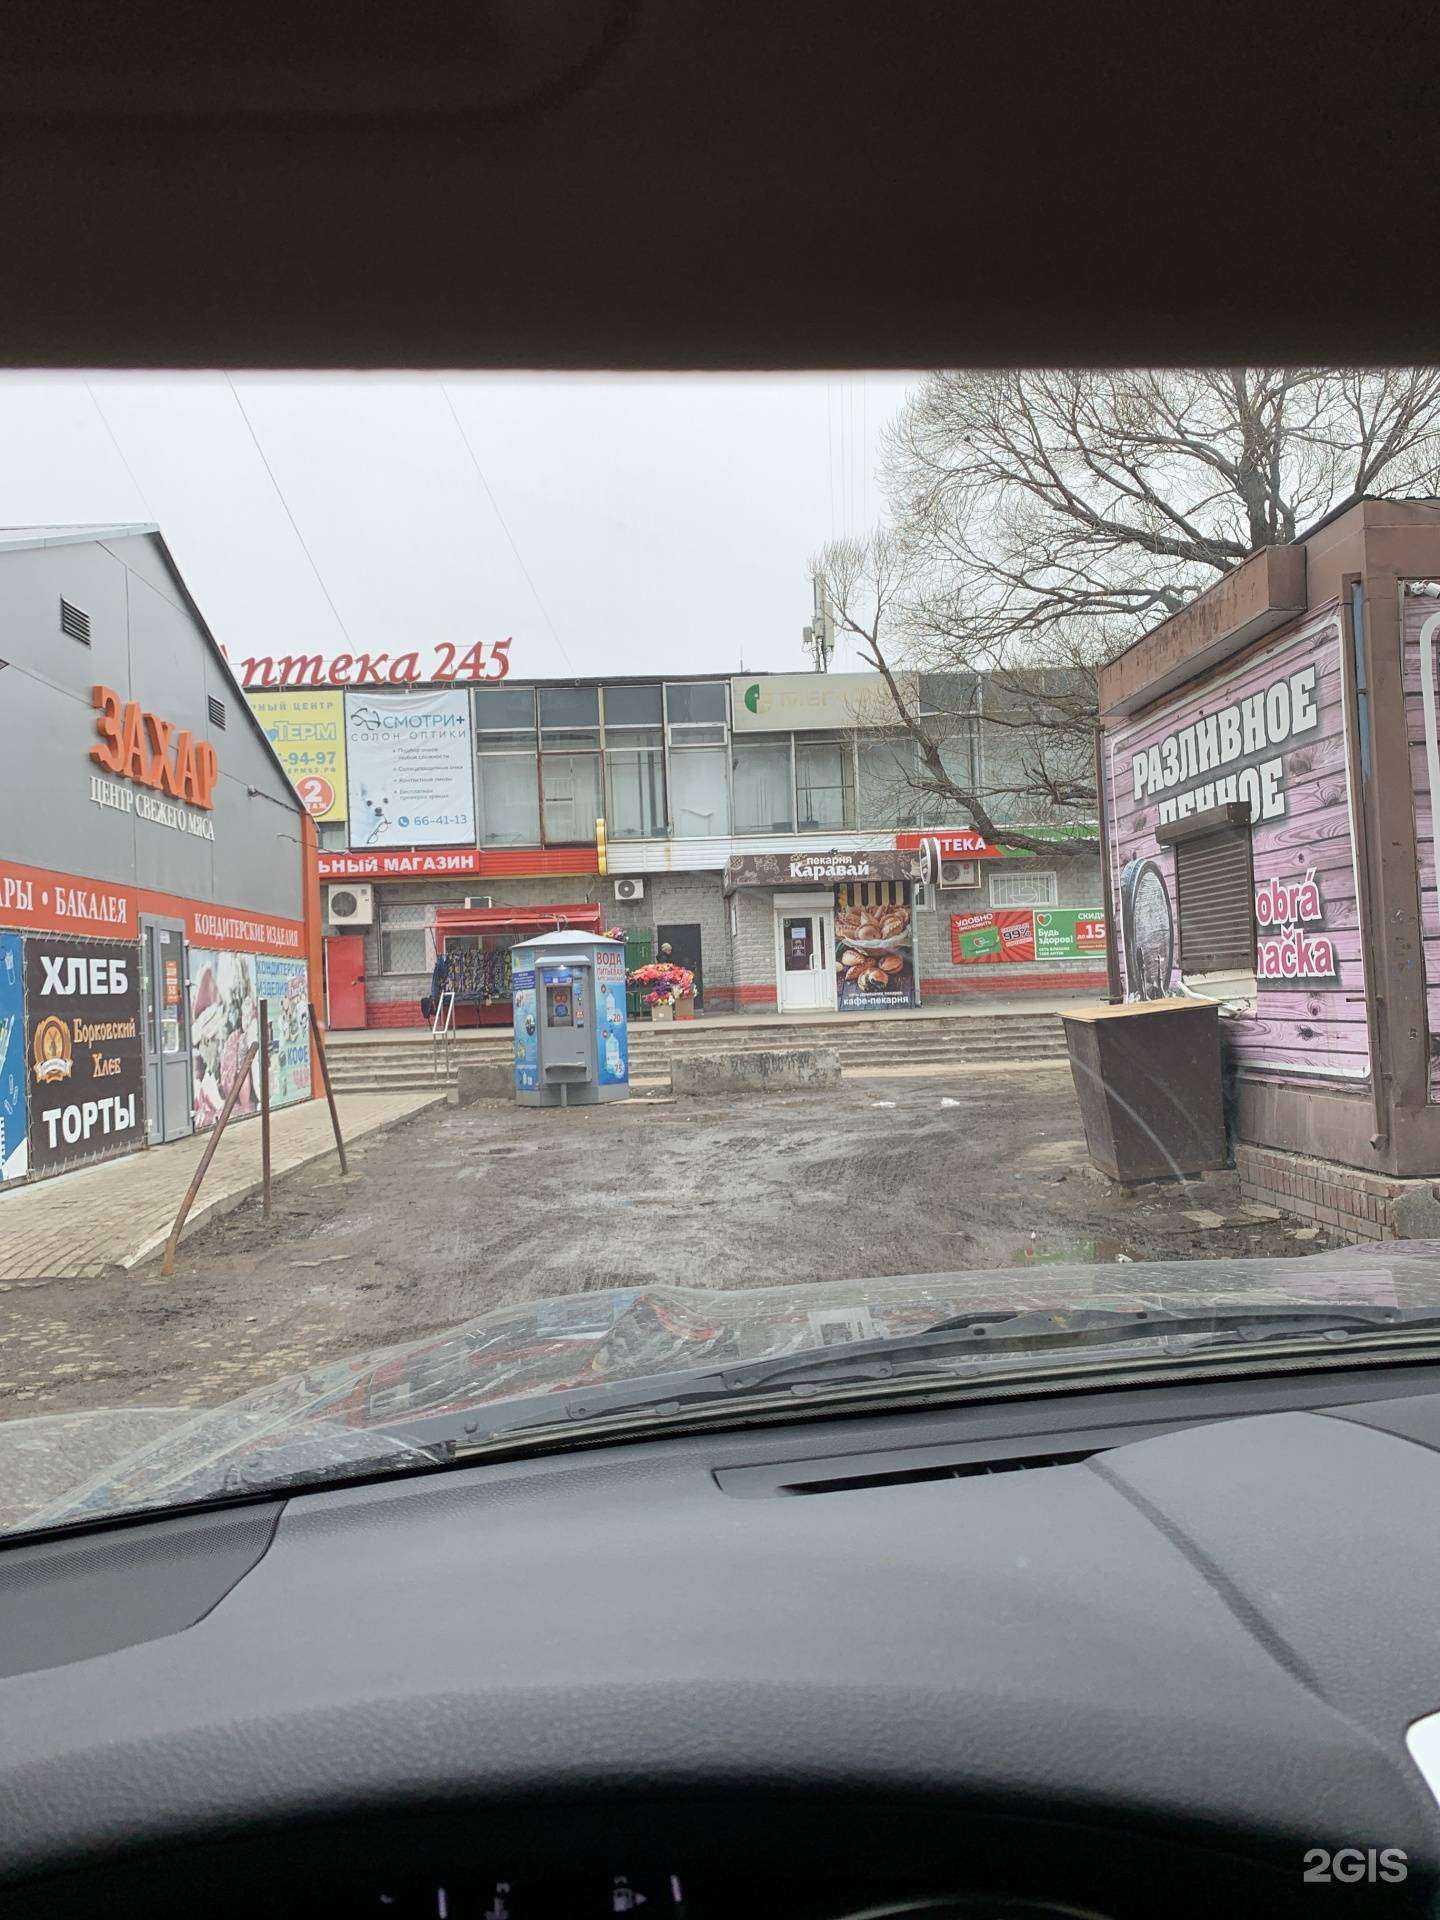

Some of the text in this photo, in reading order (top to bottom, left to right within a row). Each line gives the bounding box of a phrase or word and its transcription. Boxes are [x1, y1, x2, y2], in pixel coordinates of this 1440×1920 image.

[220, 637, 513, 688] птека 245
[251, 702, 334, 712] НЫЙ ЦЕНТР
[409, 730, 466, 740] ОПТИКИ
[1131, 665, 1318, 802] РАЗЛИВНОЕ
[89, 685, 218, 811] ЗАХАР
[278, 751, 337, 765] -94-97
[302, 780, 323, 803] 2
[90, 776, 216, 841] ЦЕНТР СВЕЖЕГО МЯСА
[414, 814, 468, 826] 66-41-13
[939, 837, 987, 852] ТЕКА
[318, 855, 475, 873] ЬНЫЙ МАГАЗИН
[789, 860, 870, 881] Каравай
[806, 855, 853, 866] пекарня
[54, 887, 128, 924] БАКАЛЕЯ
[1255, 866, 1323, 926] obrá
[194, 912, 299, 948] КОНДИТЕРСКИЕ ИЗДЕЛИЯ
[955, 913, 994, 928] УДОБНО
[1003, 926, 1031, 941] 99%
[1038, 928, 1060, 937] Будь
[1038, 935, 1074, 945] здоров!
[596, 951, 622, 965] ВОДА
[1256, 921, 1337, 980] ačka
[40, 955, 129, 996] ХЛЕБ
[73, 1017, 136, 1049] Борковский
[42, 1093, 136, 1149] ТОРТЫ
